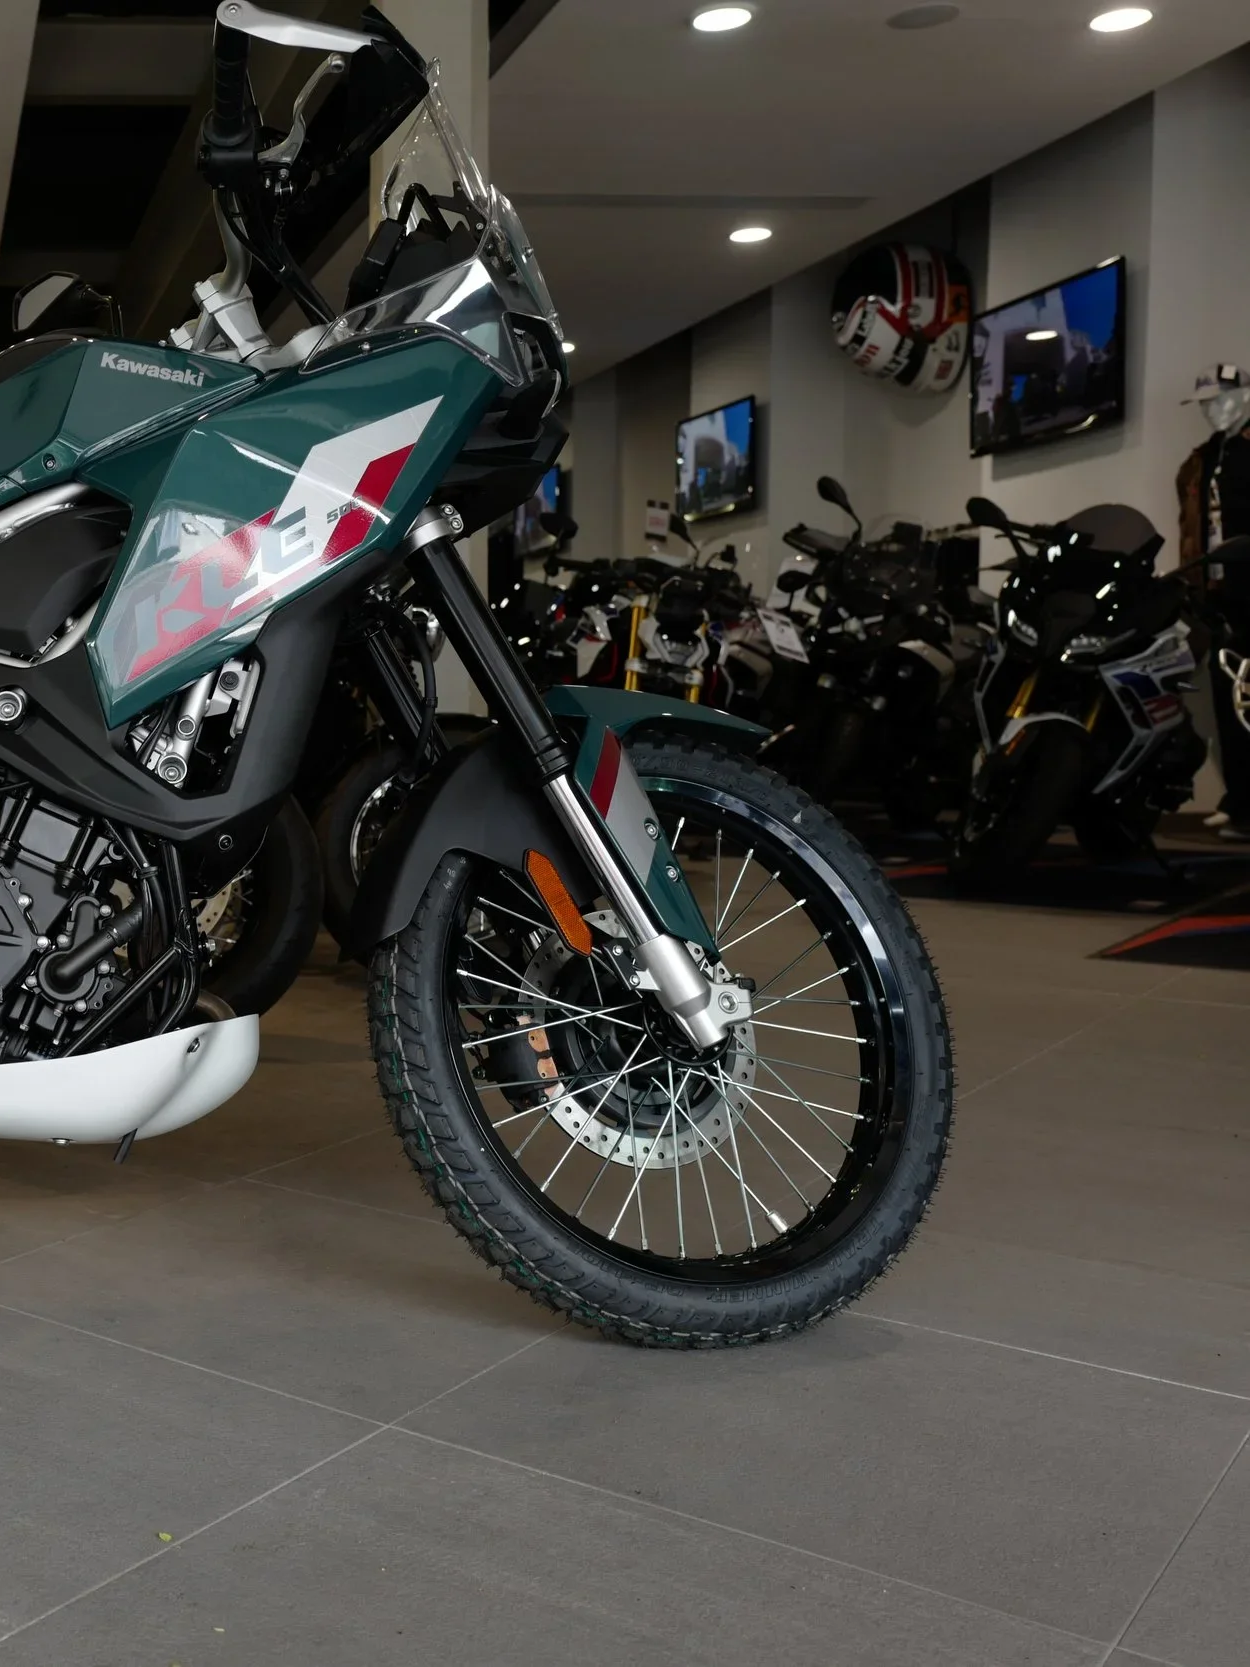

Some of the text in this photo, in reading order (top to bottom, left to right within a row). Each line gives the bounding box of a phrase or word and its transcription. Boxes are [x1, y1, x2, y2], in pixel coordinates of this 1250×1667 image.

[100, 352, 205, 387] Kawasaki
[327, 496, 363, 524] 500
[710, 1274, 816, 1303] WINNER
